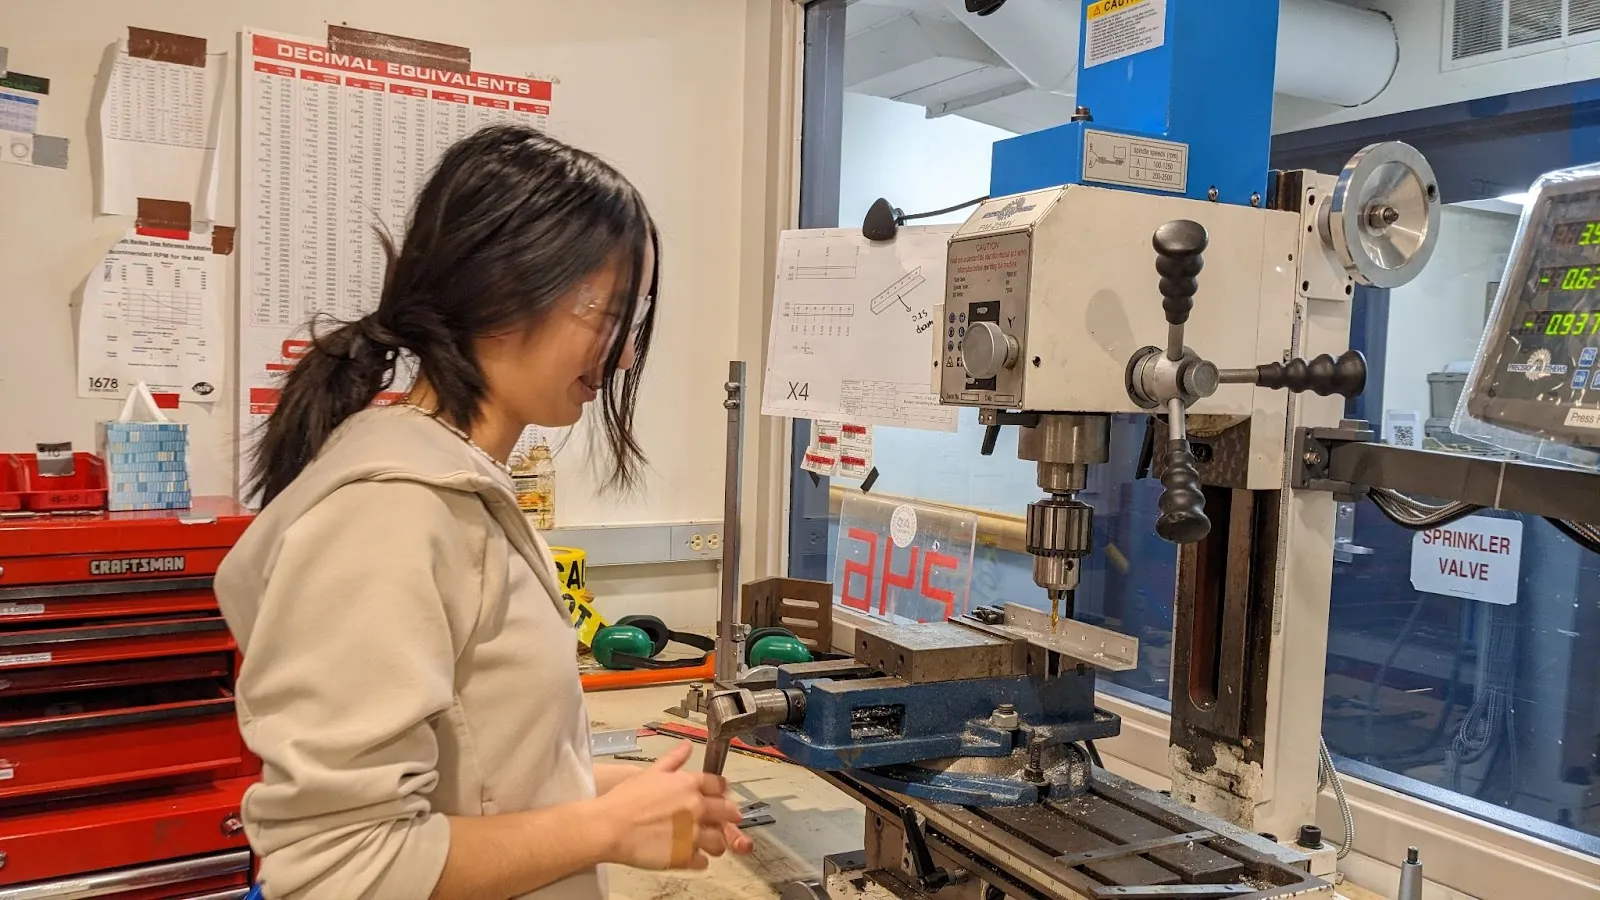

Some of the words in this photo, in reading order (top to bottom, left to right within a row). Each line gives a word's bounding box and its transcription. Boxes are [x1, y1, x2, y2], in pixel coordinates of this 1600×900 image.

[277, 43, 378, 72] DECIMAL
[386, 62, 531, 95] EQUIVALENTS
[1134, 147, 1149, 155] spindle
[1150, 150, 1166, 158] speeds
[1167, 152, 1179, 160] (rpm)
[976, 241, 1000, 252] CAUTION
[88, 377, 119, 389] 1678
[786, 381, 810, 401] X4
[1570, 412, 1594, 423] Press
[1422, 529, 1511, 555] SPRINKLER
[90, 557, 185, 576] CRAFTSMAN
[1438, 557, 1489, 581] VALVE
